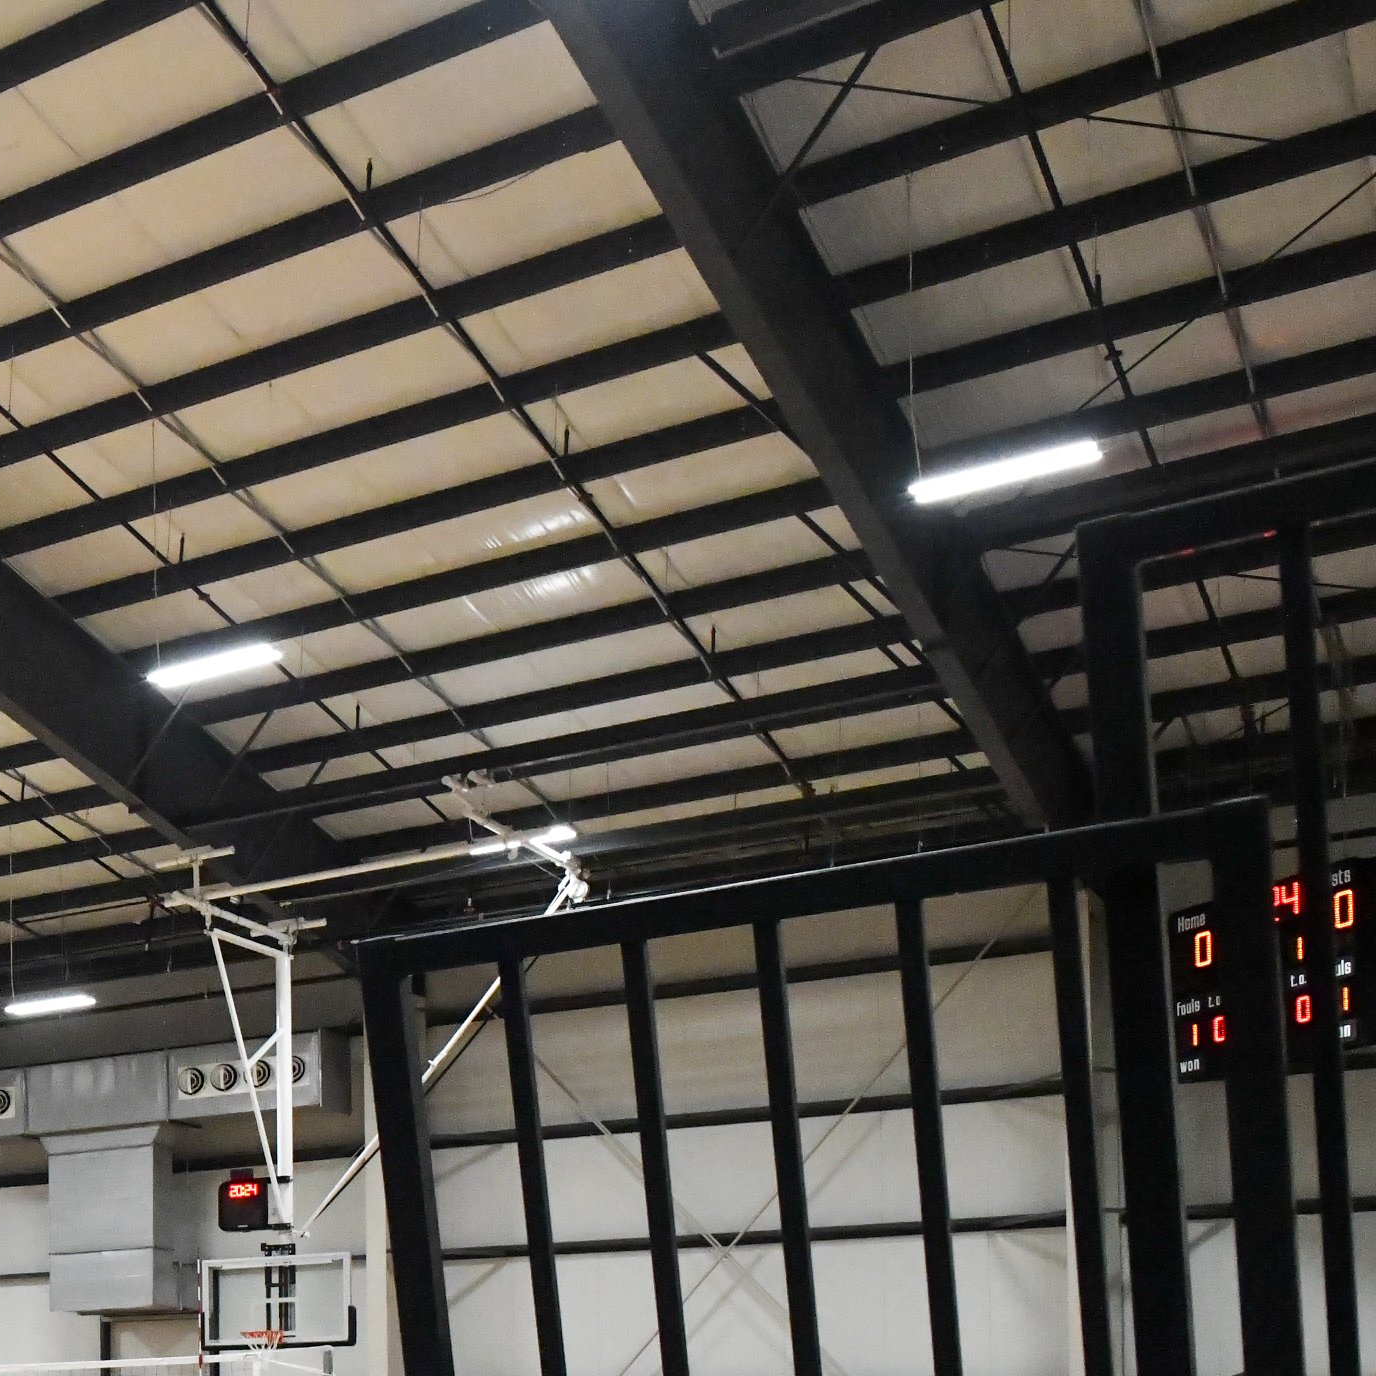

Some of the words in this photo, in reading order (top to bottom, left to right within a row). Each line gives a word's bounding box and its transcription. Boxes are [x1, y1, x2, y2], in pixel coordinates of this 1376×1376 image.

[1333, 889, 1354, 929] 0
[1177, 912, 1206, 933] Home
[1194, 930, 1212, 968] 0
[1297, 936, 1303, 960] 1
[1176, 998, 1201, 1017] fouls
[1295, 994, 1312, 1023] 0
[1342, 986, 1349, 1011] 1
[1191, 1023, 1198, 1047] 1
[1179, 1057, 1200, 1073] won
[229, 1183, 258, 1198] 20:24
